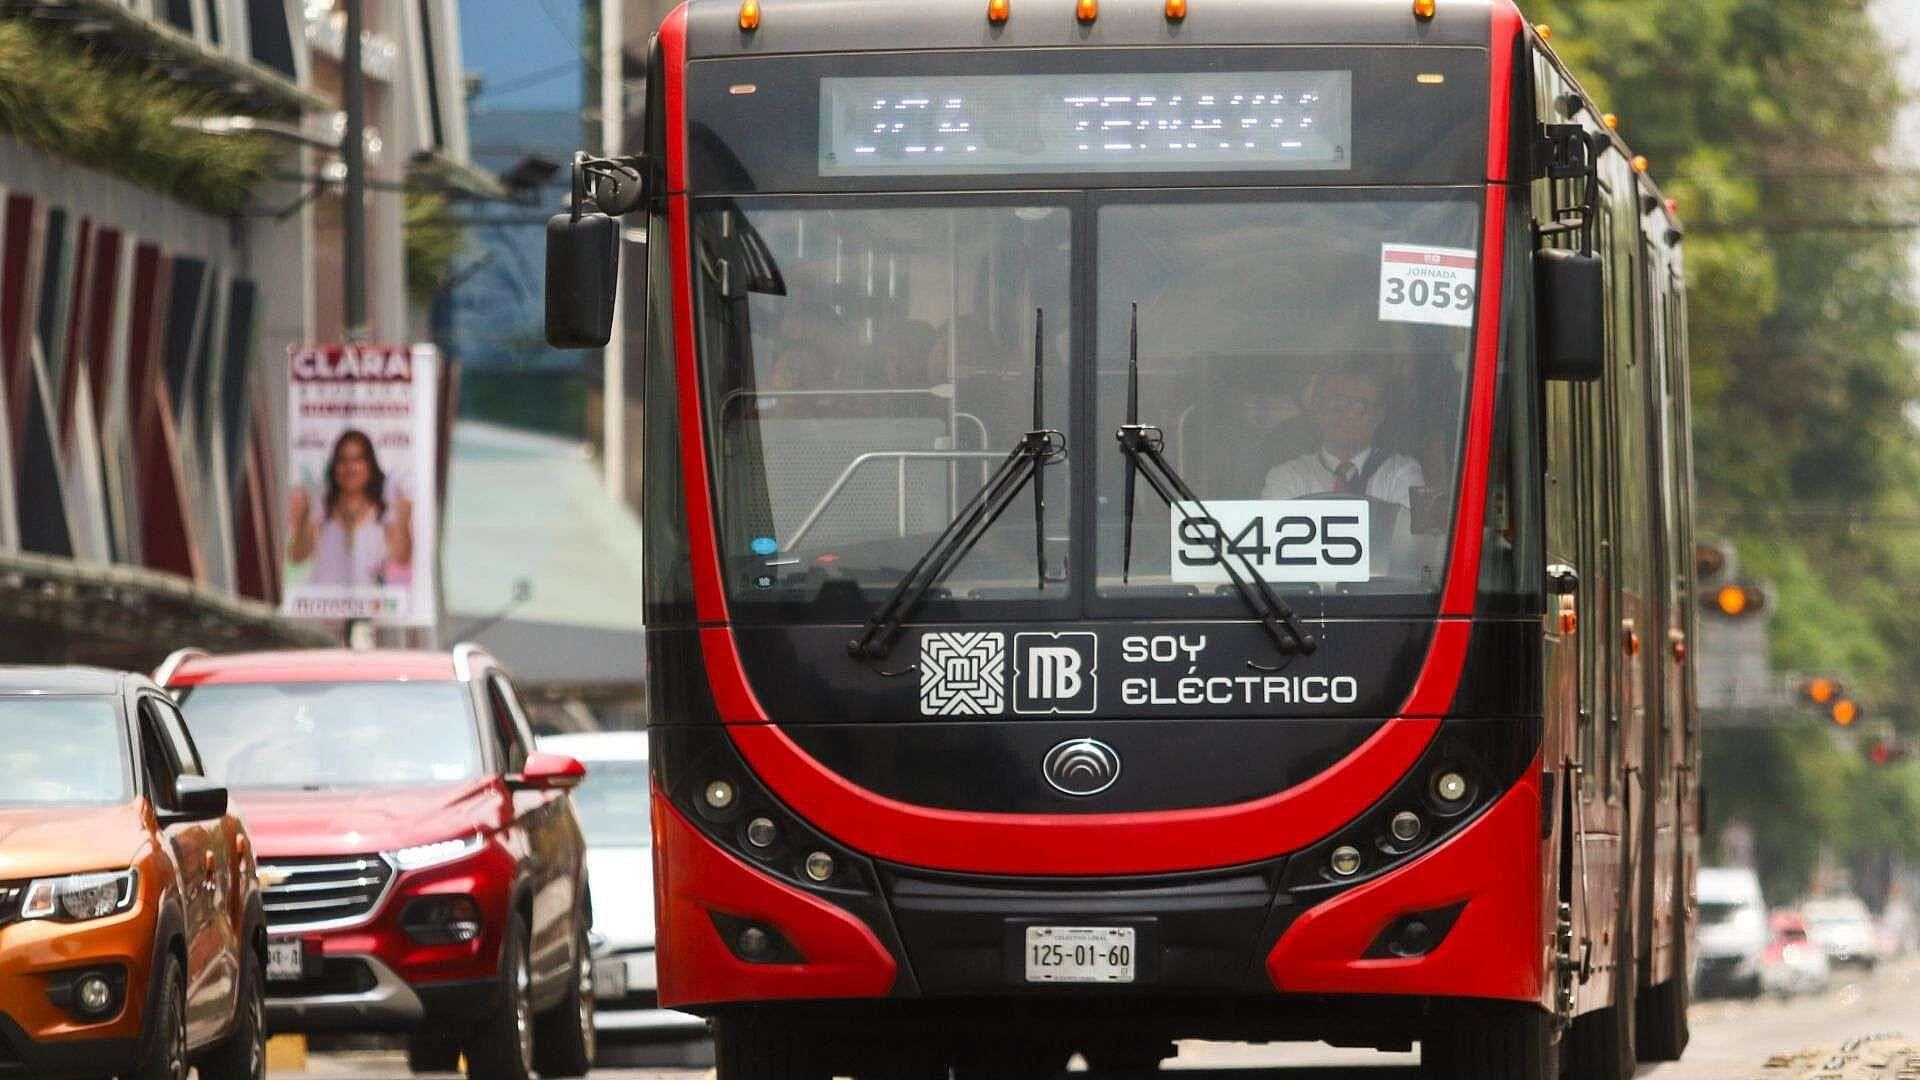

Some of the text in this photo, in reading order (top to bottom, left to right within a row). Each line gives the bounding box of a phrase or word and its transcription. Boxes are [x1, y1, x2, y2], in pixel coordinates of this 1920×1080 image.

[1407, 267, 1457, 279] JORNADA
[1385, 278, 1474, 311] 3059
[294, 350, 411, 376] CLARA
[1178, 516, 1363, 566] 9425
[1122, 636, 1207, 662] SOY
[1029, 647, 1083, 699] MB
[1122, 667, 1357, 704] ELÉCTRICO
[1033, 944, 1130, 966] 125-01-60
